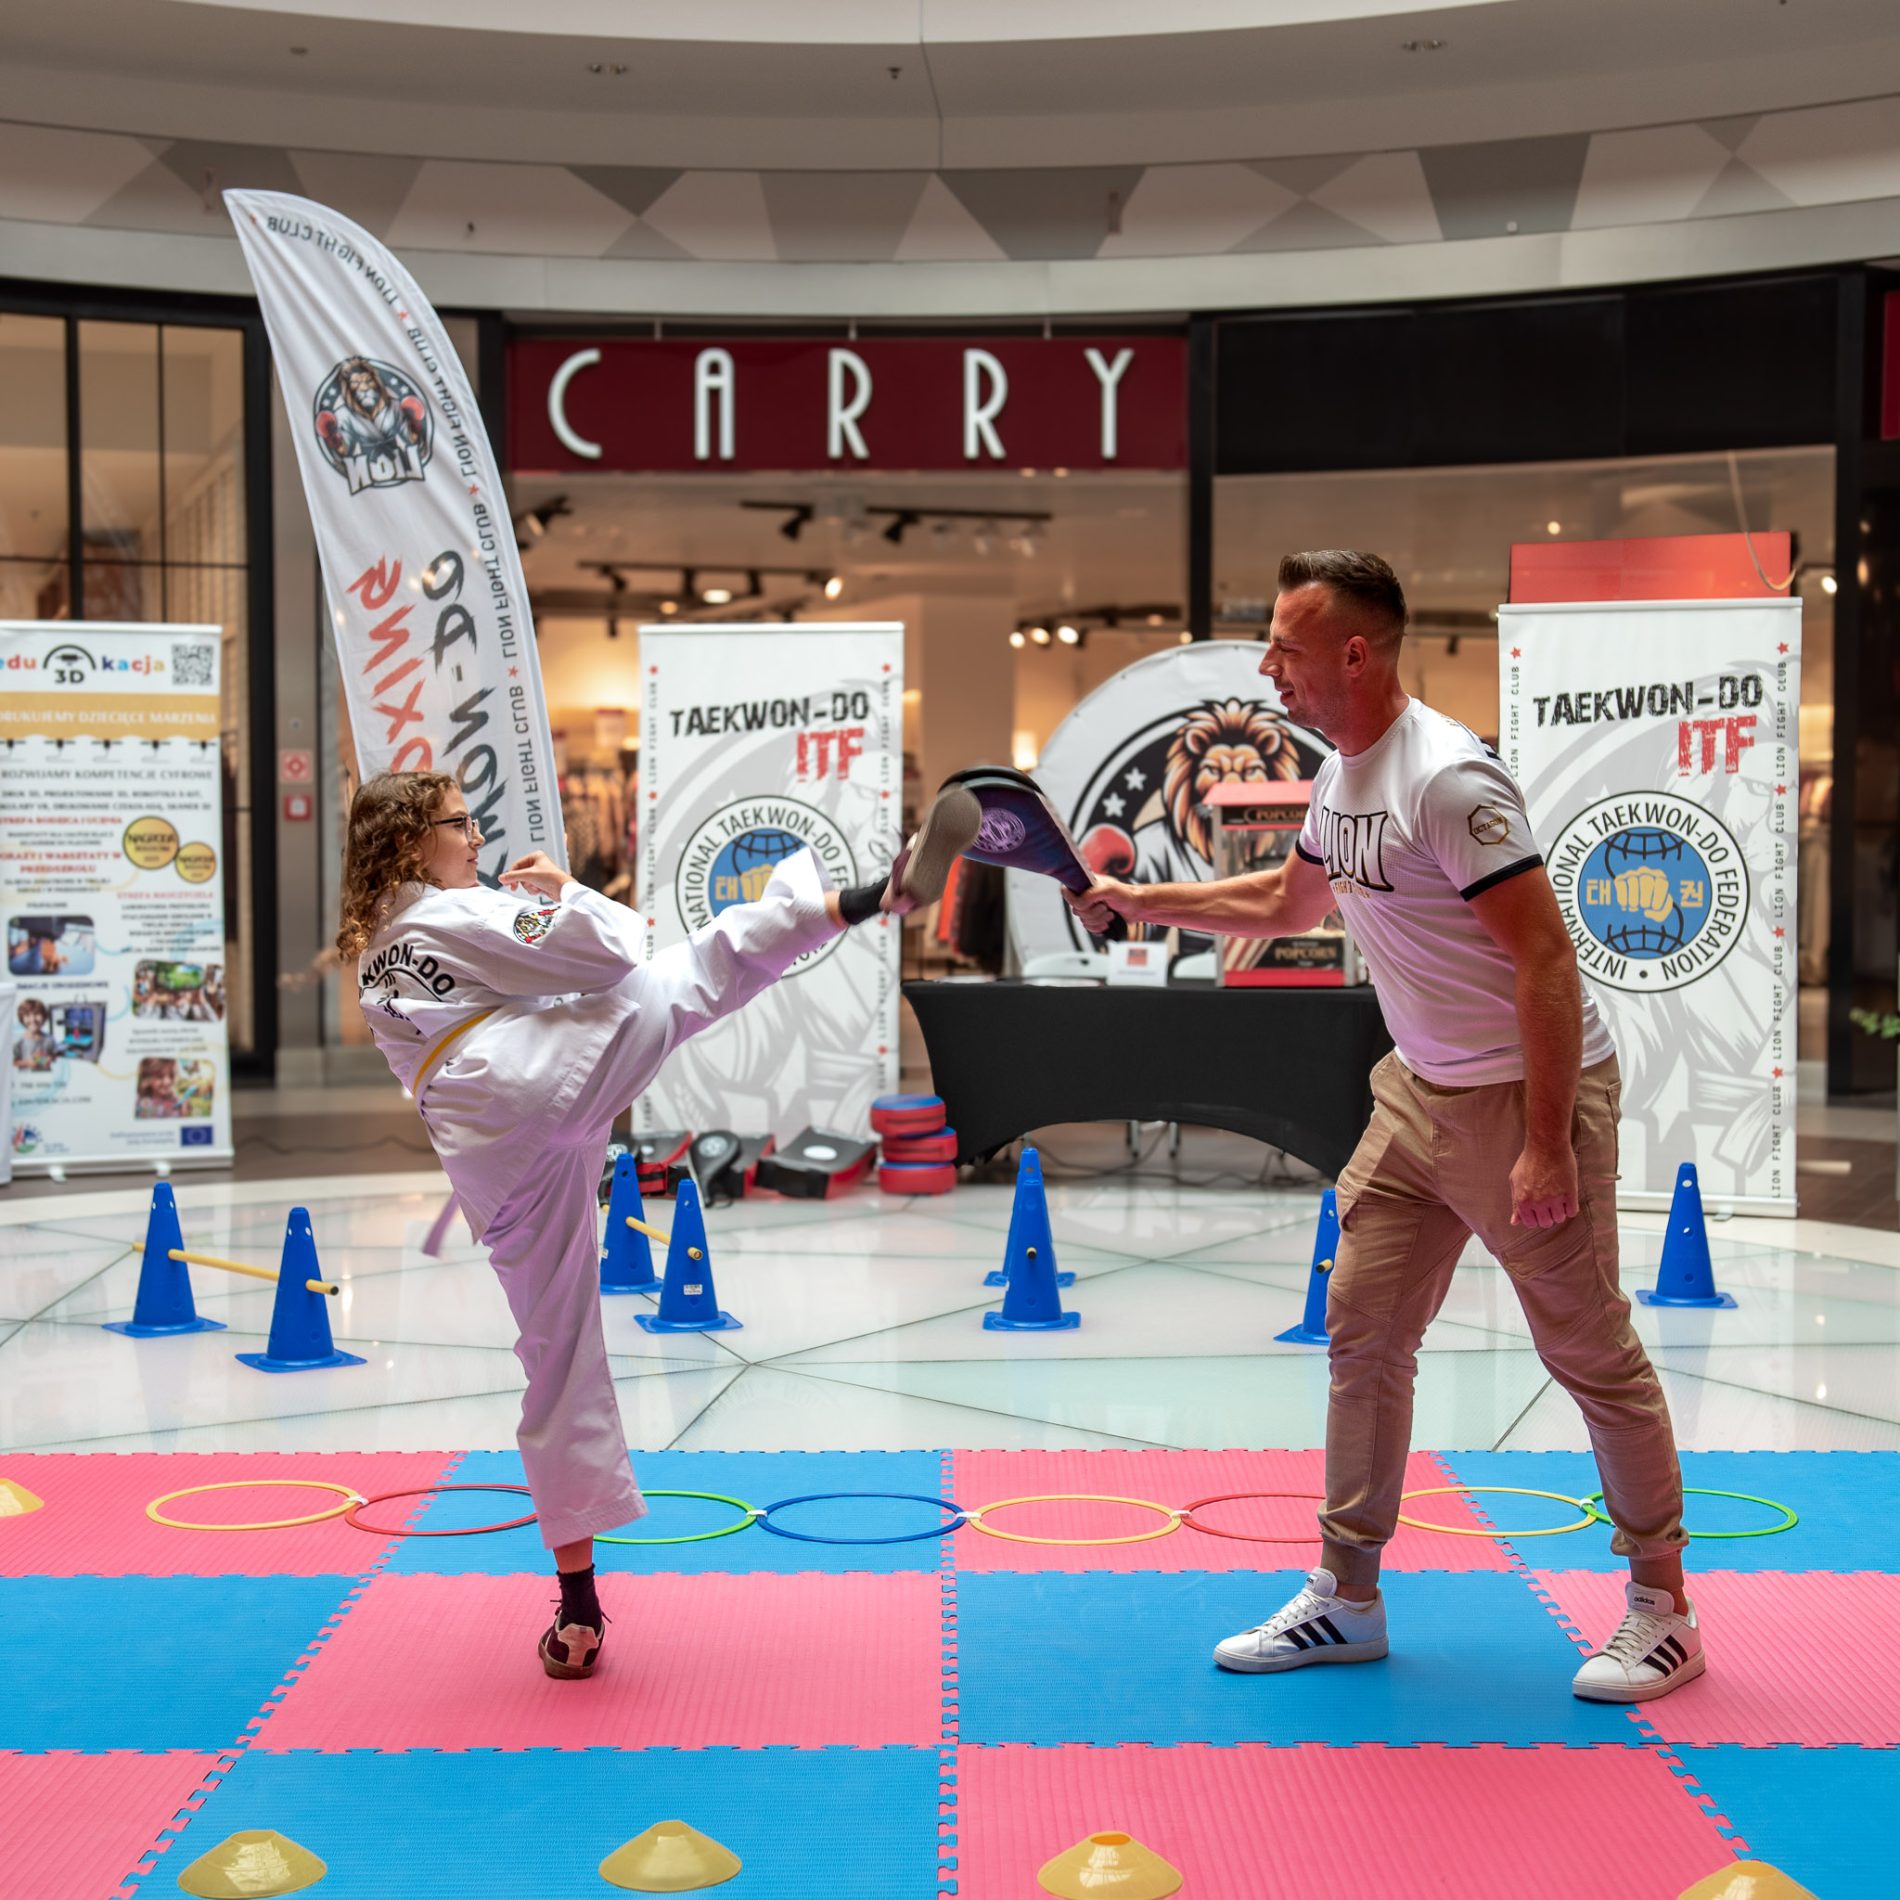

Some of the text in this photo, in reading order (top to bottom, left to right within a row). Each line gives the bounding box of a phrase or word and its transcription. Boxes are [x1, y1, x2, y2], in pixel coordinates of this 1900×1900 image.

[547, 347, 1134, 461] CARRY
[54, 669, 85, 684] 3D
[101, 655, 166, 676] kacja
[670, 690, 869, 737] TAEKWON-DO
[1532, 674, 1763, 728] TAEKWON-DO
[795, 727, 865, 783] ITF
[1511, 666, 1520, 777] LION FIGHT CLUB
[1678, 714, 1757, 777] ITF
[1776, 661, 1788, 777] LION FIGHT CLUB
[685, 835, 722, 930] NATIONAL
[717, 806, 840, 861] TAEKWON-DO
[1319, 806, 1394, 892] LION
[1586, 879, 1703, 907] 태 권
[1587, 802, 1729, 863] TAEKWON-DO
[1661, 867, 1739, 981] FEDERATION
[1774, 803, 1785, 918] LION FIGHT CLUB
[361, 943, 455, 996] KWON-DO
[1773, 945, 1783, 1059] LION FIGHT CLUB
[1771, 1085, 1782, 1199] LION FIGHT CLUB
